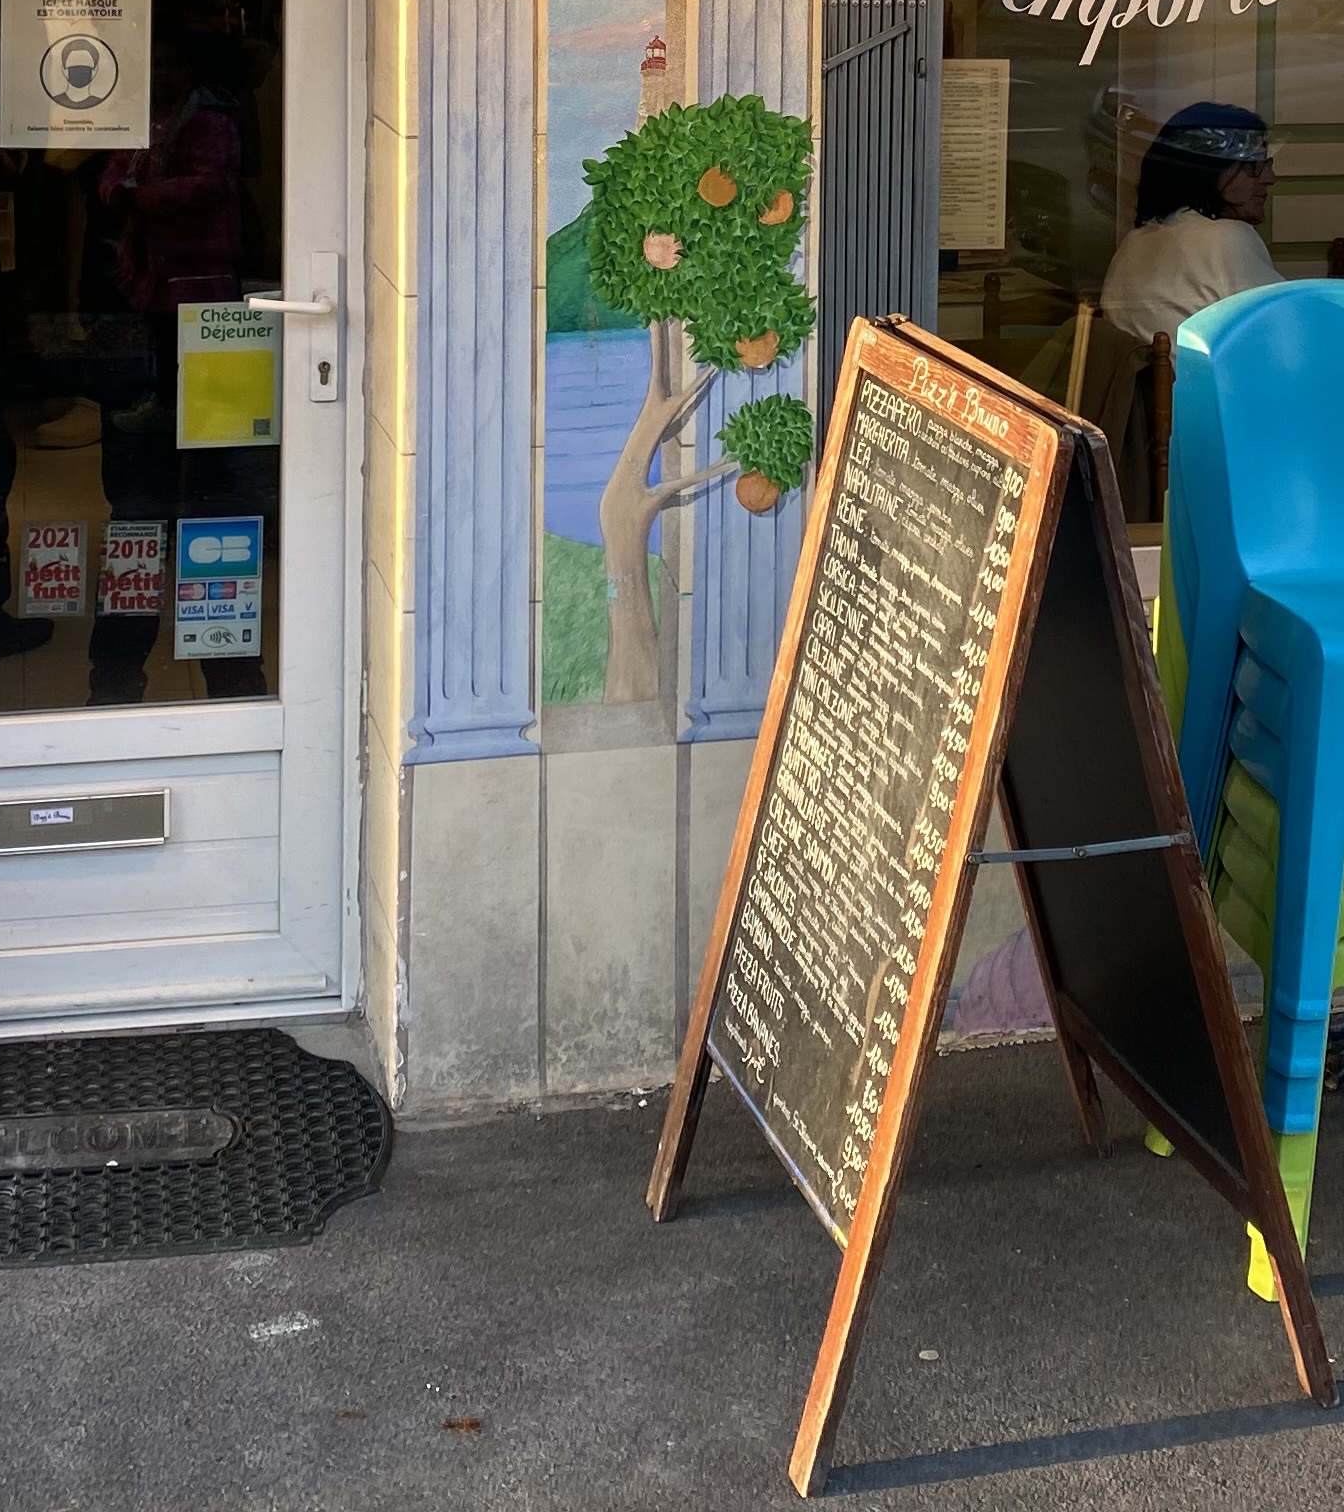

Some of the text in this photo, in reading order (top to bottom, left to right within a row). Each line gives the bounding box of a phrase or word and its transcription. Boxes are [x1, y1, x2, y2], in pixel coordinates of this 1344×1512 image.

[37, 9, 123, 17] EST OBLIGATOIRE
[76, 0, 117, 9] MASQUE
[200, 308, 263, 325] Chèque
[200, 325, 274, 342] Déjeuner
[961, 388, 1009, 438] Bruno
[28, 527, 79, 548] 2021
[108, 540, 159, 559] 2018
[24, 565, 80, 587] petit
[100, 571, 162, 596] petit
[181, 605, 204, 615] VISA
[212, 604, 234, 614] VISA
[732, 937, 758, 984] PIZZA
[726, 972, 747, 1017] PIZZA
